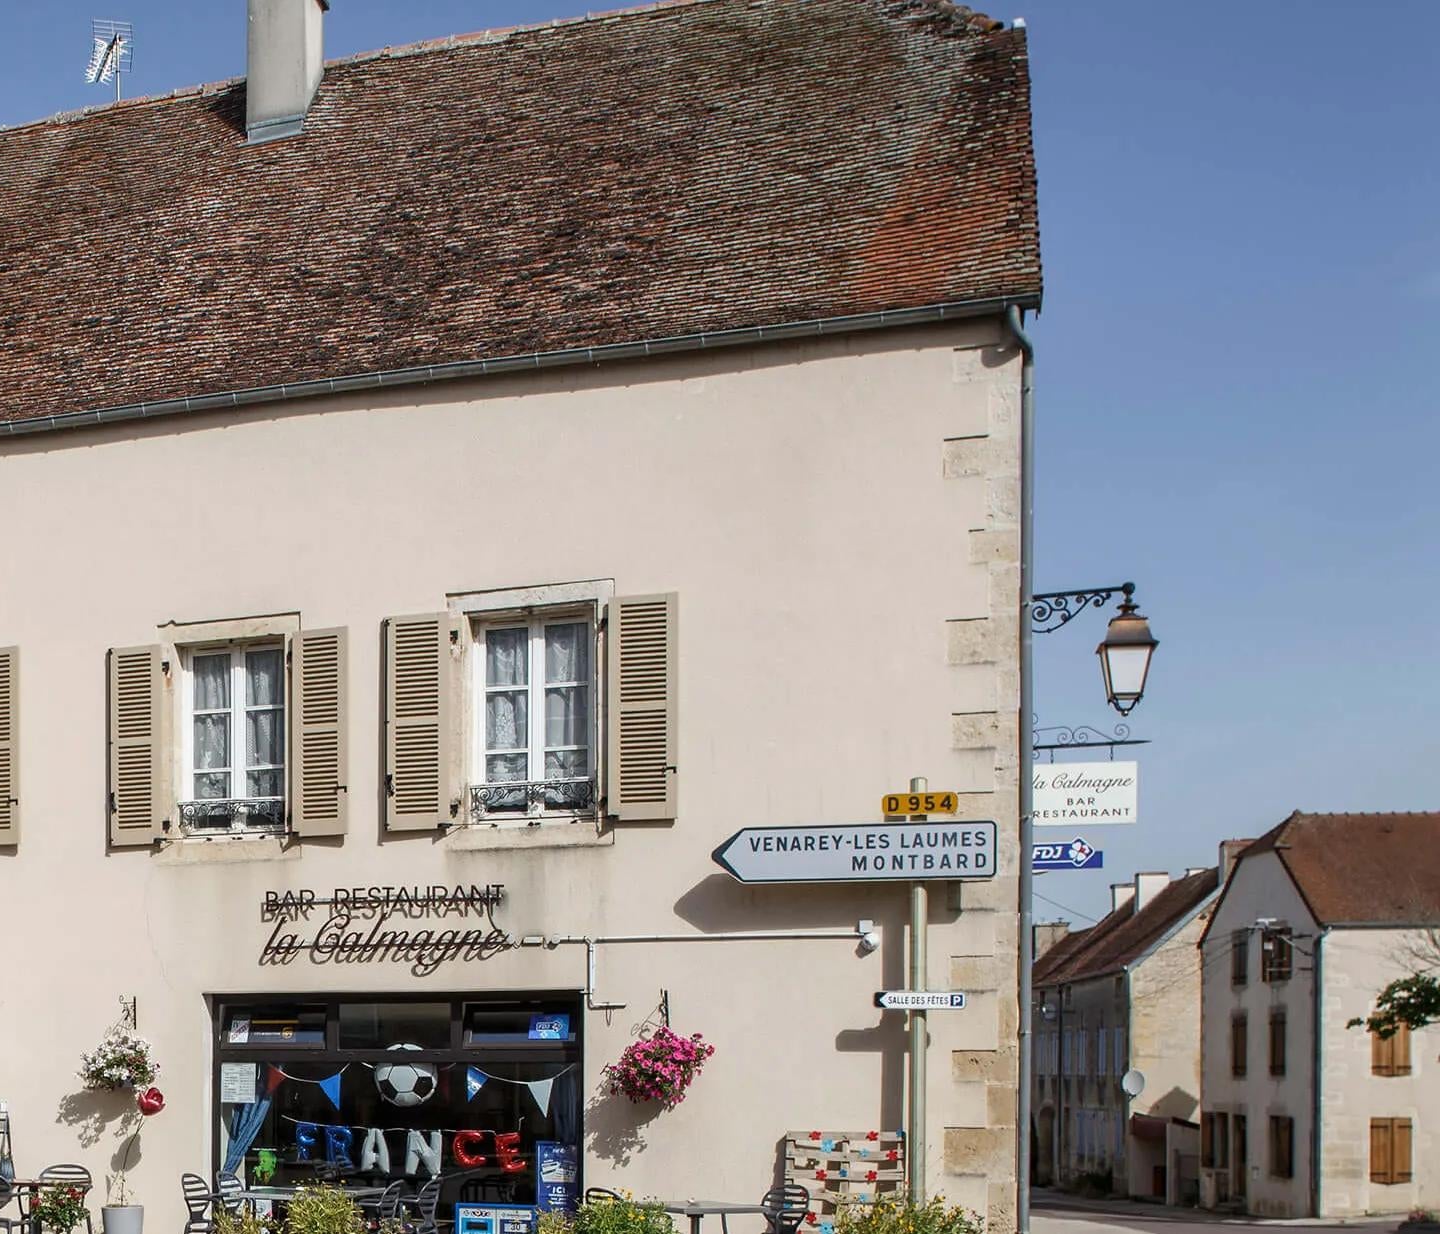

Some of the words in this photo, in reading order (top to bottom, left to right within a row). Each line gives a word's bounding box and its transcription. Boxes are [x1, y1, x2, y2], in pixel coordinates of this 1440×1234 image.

[1033, 772, 1047, 790] la
[1052, 772, 1135, 794] Calmagne
[887, 796, 900, 812] D
[908, 795, 953, 811] 954
[1066, 797, 1096, 806] BAR
[1033, 807, 1130, 818] RESTAURANT
[749, 833, 890, 852] VENAREY-LES
[900, 831, 986, 849] LAUMES
[1032, 845, 1063, 859] FDJ
[852, 853, 987, 871] MONTBARD
[265, 889, 315, 912] BAR
[333, 884, 505, 910] RESTAURANT
[264, 915, 305, 956] la
[312, 911, 509, 967] Calmagne
[888, 996, 909, 1005] SALLE
[911, 996, 926, 1005] DES
[927, 995, 949, 1005] FÊTES
[295, 1121, 527, 1175] FRANCE
